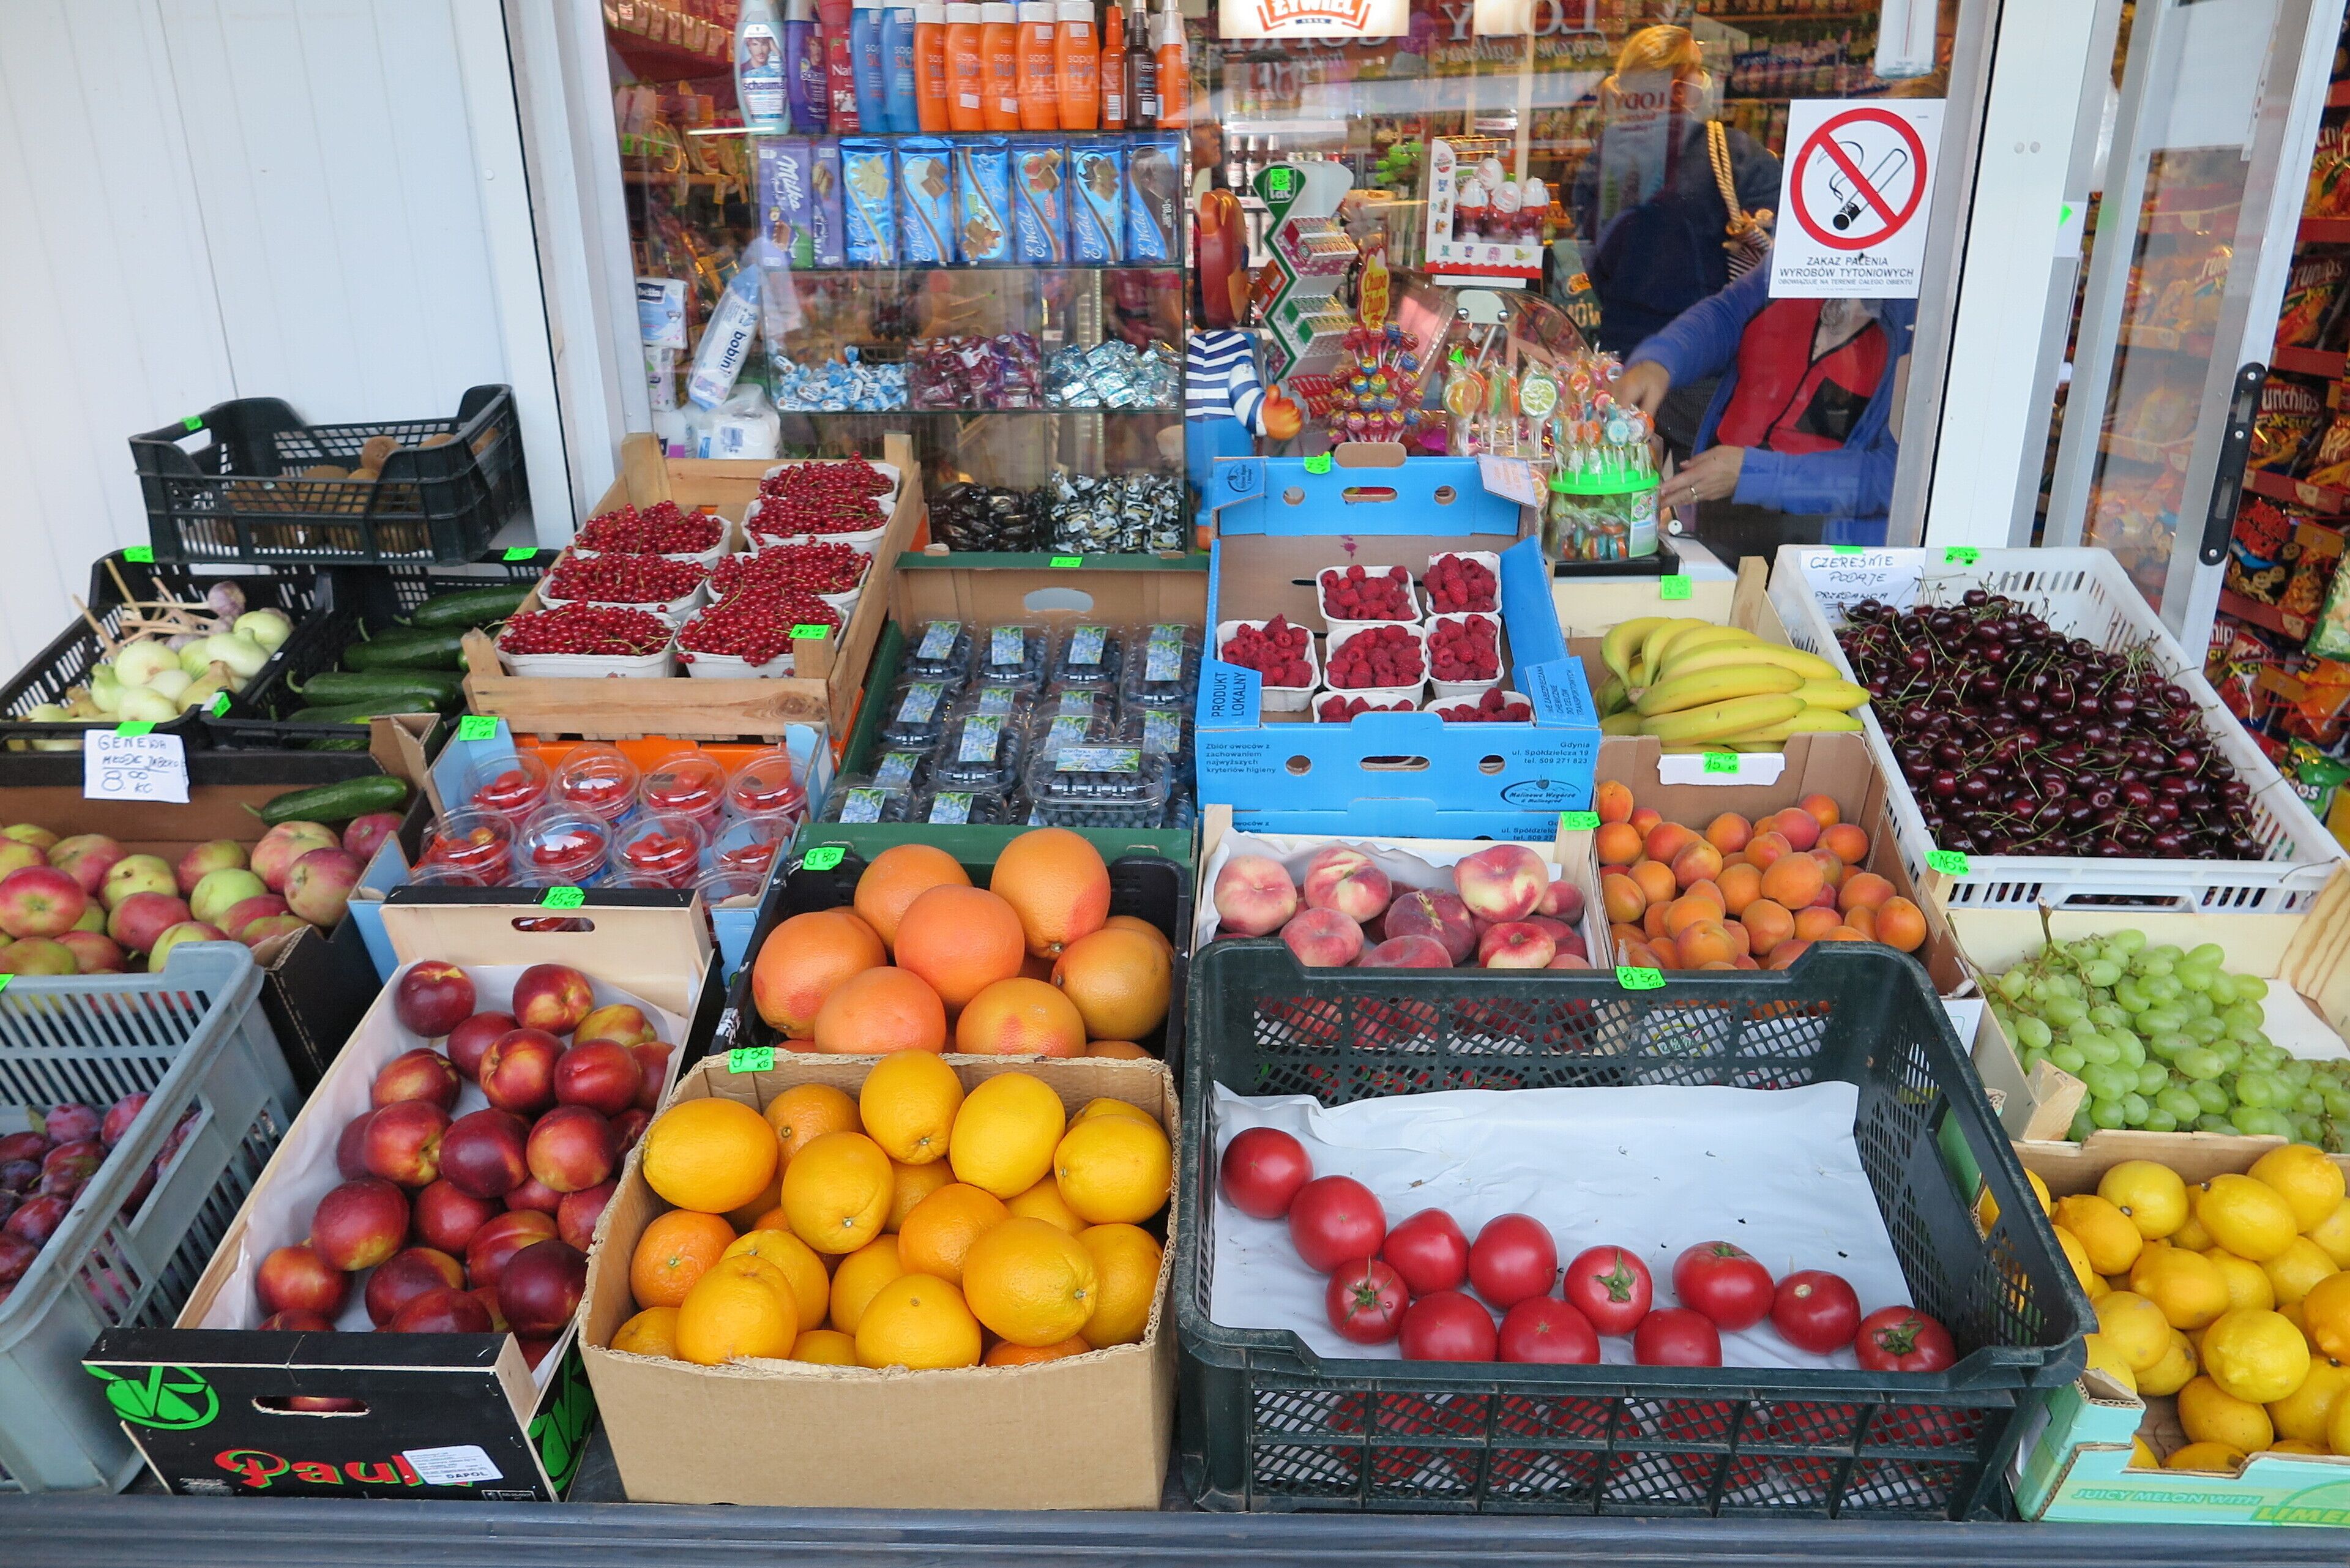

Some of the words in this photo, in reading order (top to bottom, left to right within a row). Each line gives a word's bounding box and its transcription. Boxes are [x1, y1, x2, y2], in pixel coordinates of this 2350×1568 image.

[1806, 256, 1841, 267] ZAKAZ
[1840, 268, 1914, 278] TYTONIOWYCH
[1211, 672, 1228, 717] PRODUKT
[1231, 671, 1247, 717] LOKALNY
[1524, 749, 1577, 758] Spółdzielcza
[446, 1471, 489, 1479] DAPOL
[2072, 1488, 2132, 1501] JUICY
[2134, 1490, 2204, 1504] MELON
[2207, 1493, 2263, 1506] WITH
